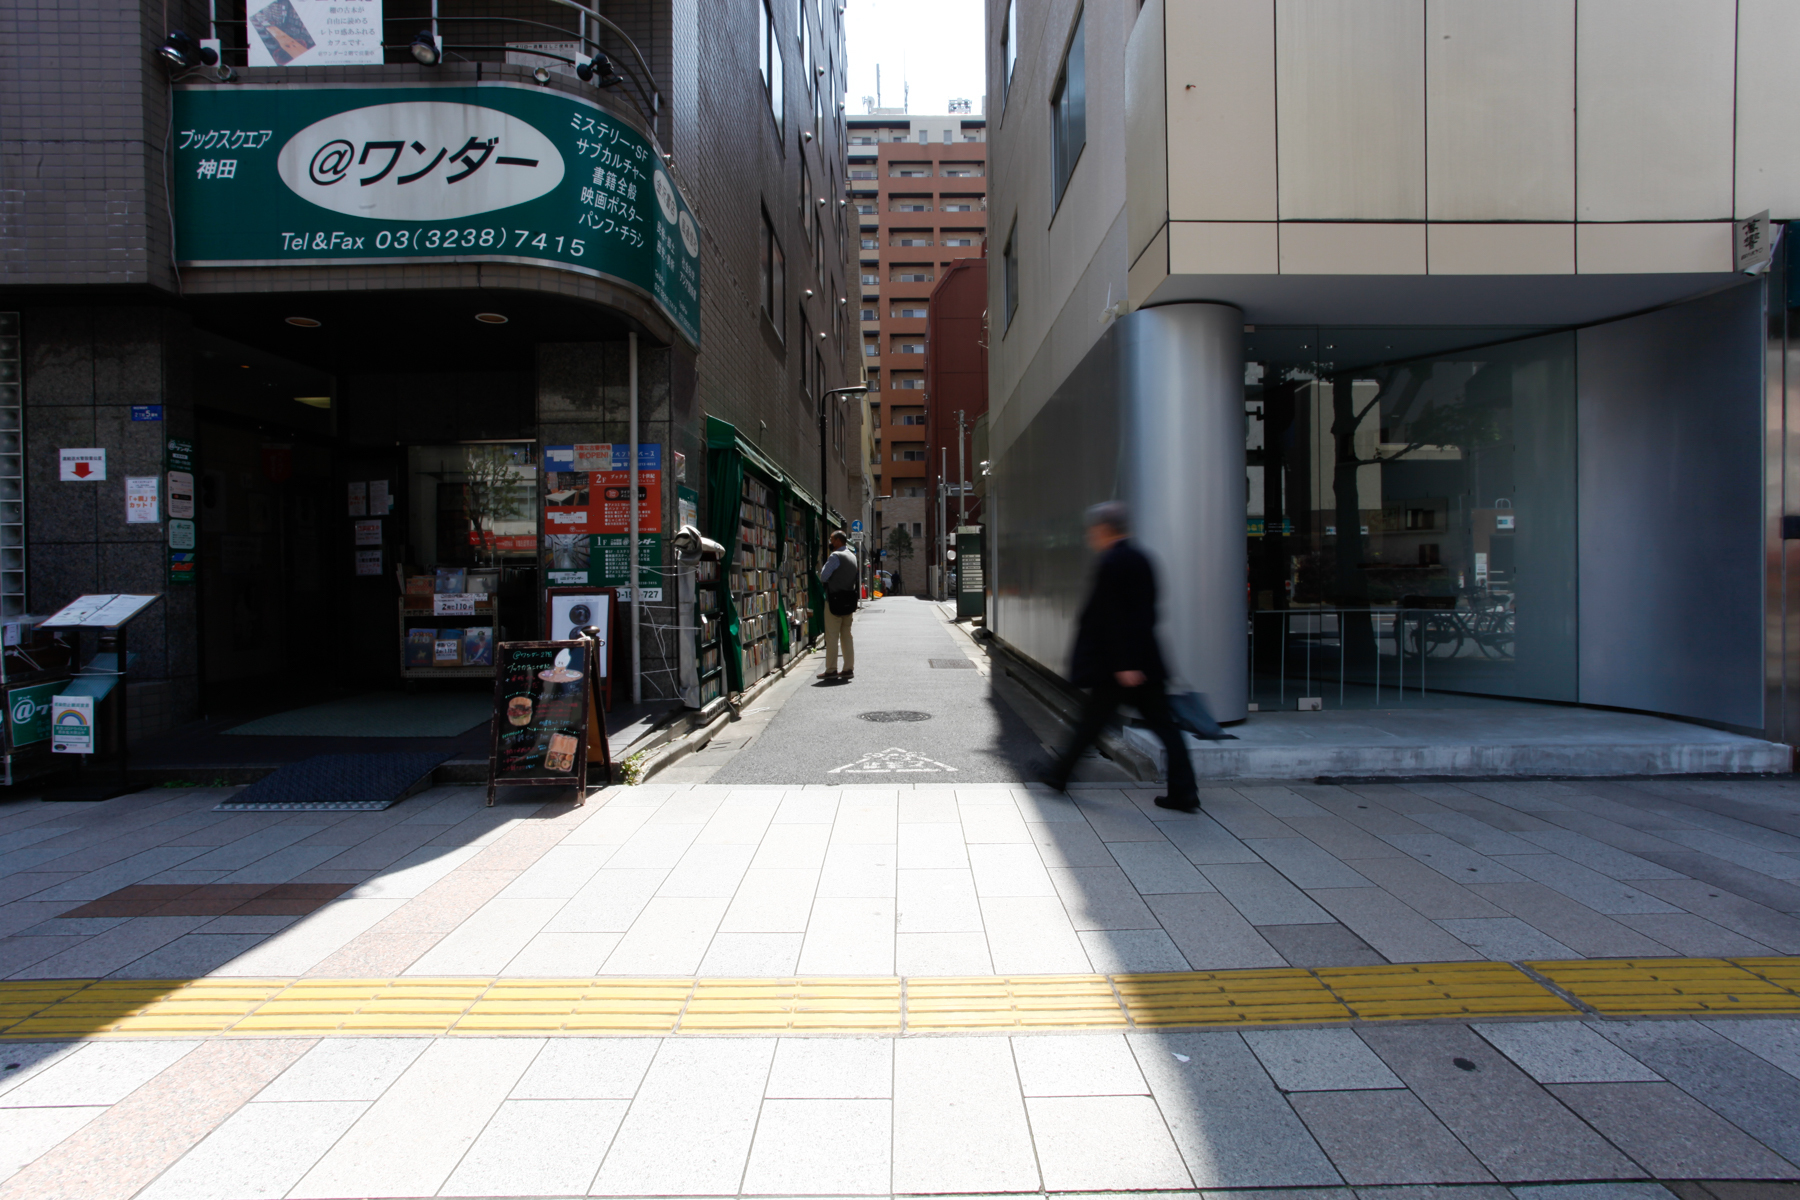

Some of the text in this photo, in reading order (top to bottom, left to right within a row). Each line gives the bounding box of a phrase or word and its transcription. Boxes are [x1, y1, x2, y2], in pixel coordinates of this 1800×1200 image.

[326, 17, 368, 25] 自由に読める
[329, 6, 365, 14] 棚の古本が
[320, 28, 376, 36] レトロ感あふれる
[178, 128, 272, 150] ブックスクエア
[570, 112, 649, 163] ミステリー・SF
[196, 158, 237, 180] 神田
[308, 135, 540, 187] @ワンダー
[576, 137, 647, 181] サブカルチャー
[592, 166, 638, 202] 書籍全般
[580, 186, 644, 222] 映画ポスター
[281, 227, 586, 257] Tel&Fax 03(3238)7415
[578, 210, 644, 248] パンフ・チラシ
[596, 473, 607, 484] 2F
